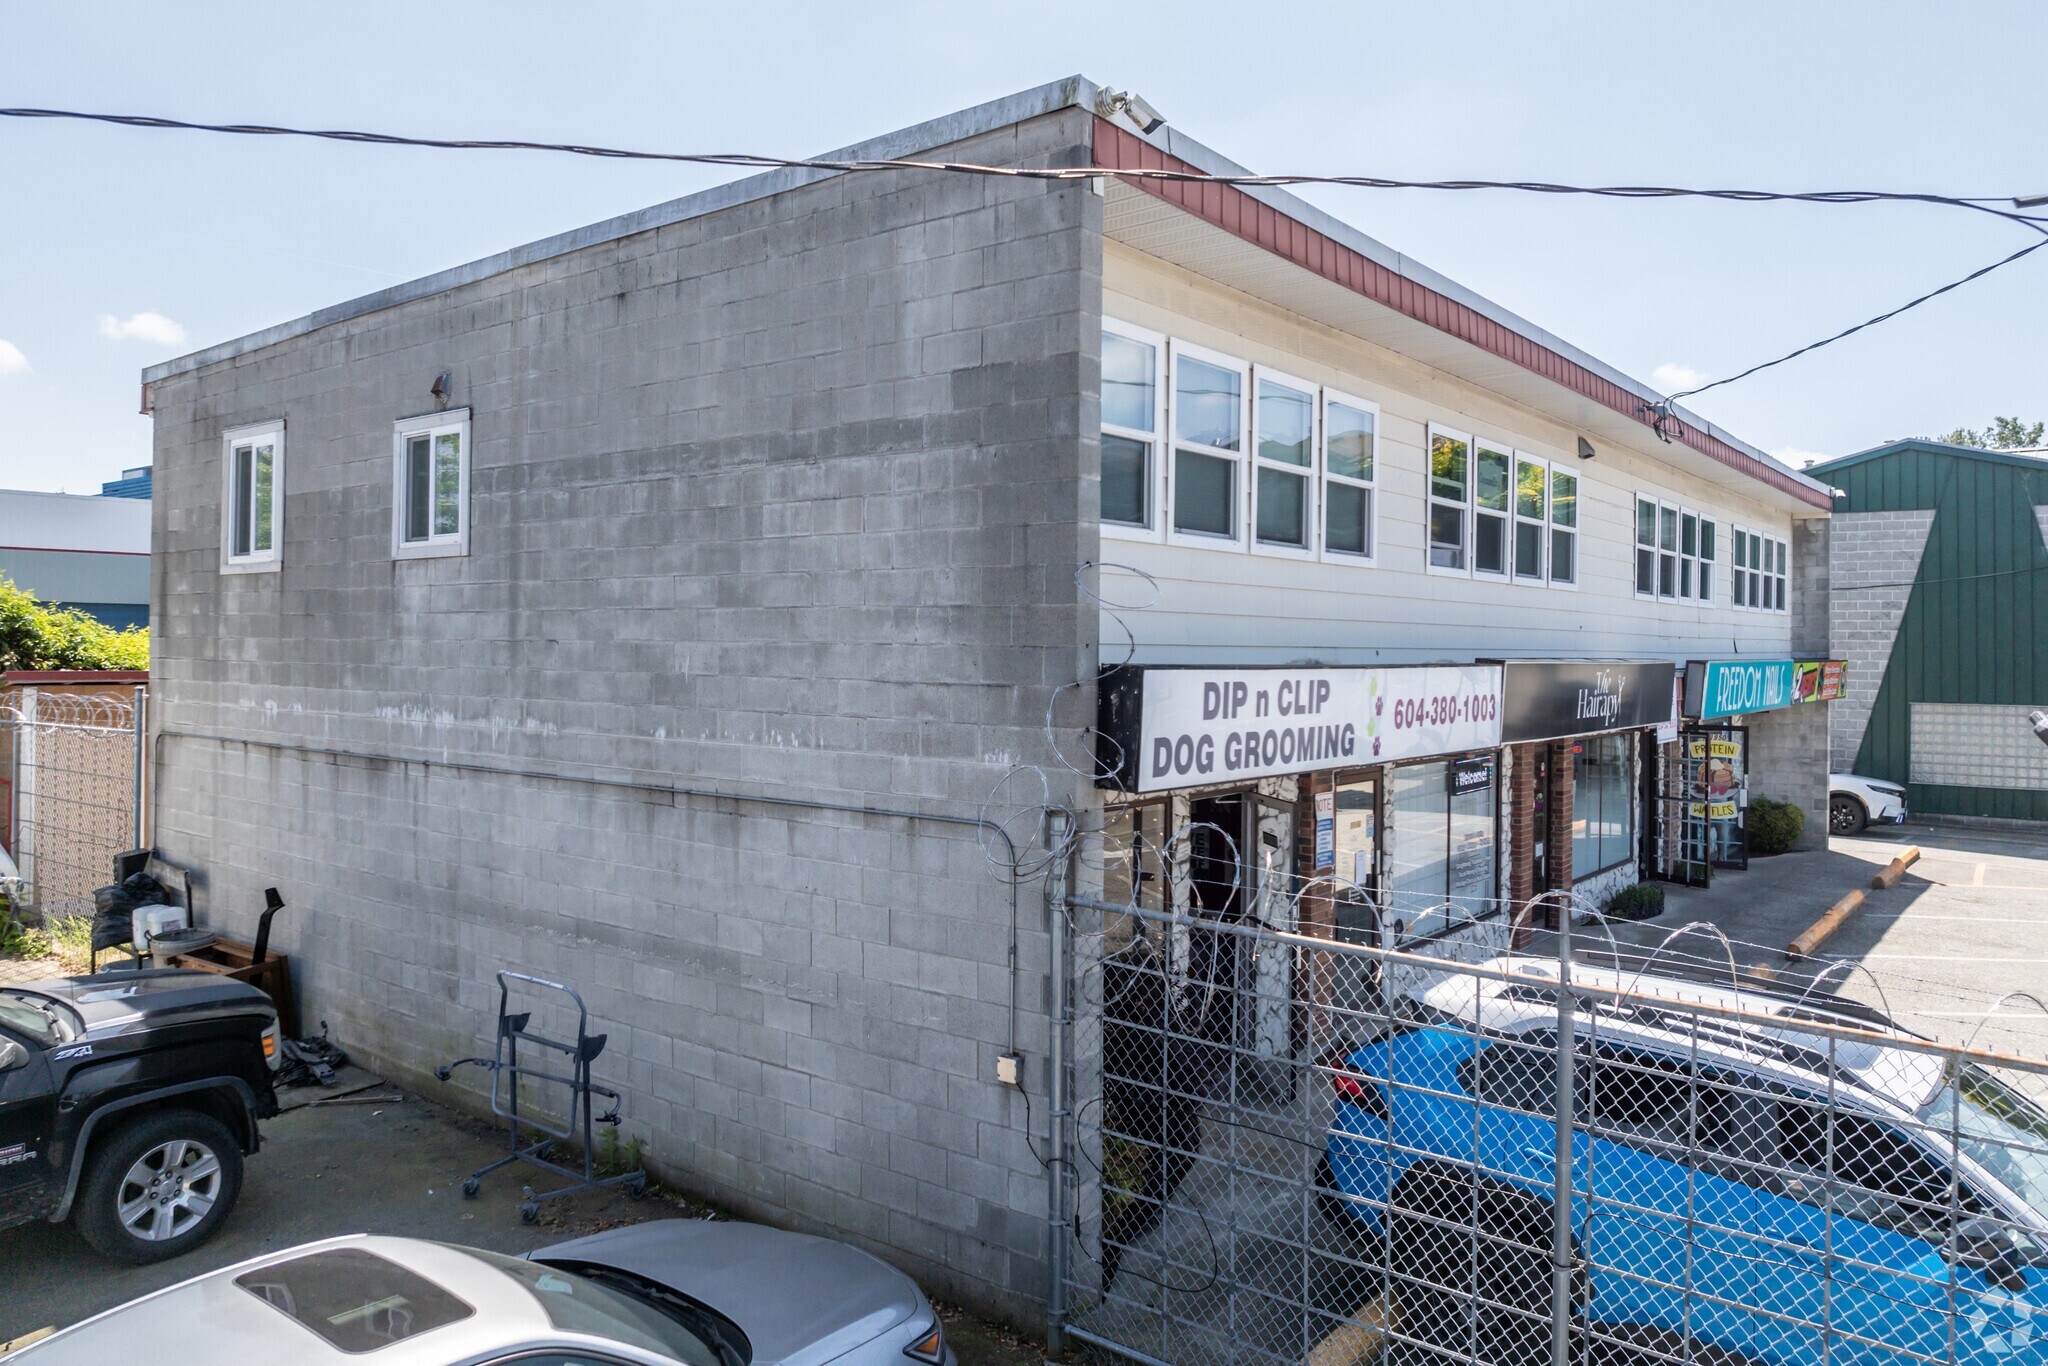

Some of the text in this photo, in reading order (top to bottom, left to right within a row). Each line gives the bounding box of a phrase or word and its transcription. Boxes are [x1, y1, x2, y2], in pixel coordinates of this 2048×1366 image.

[1203, 679, 1330, 720] DIP n CLIP
[1594, 668, 1612, 695] The
[1716, 665, 1762, 712] FREEDOM
[1763, 664, 1785, 706] NAILS
[1394, 694, 1496, 730] 604-380-1003
[1576, 688, 1621, 727] Hairapy
[1152, 722, 1355, 778] DOG GROOMING
[1694, 743, 1735, 755] PRTEIN
[1693, 804, 1735, 817] WAFLES
